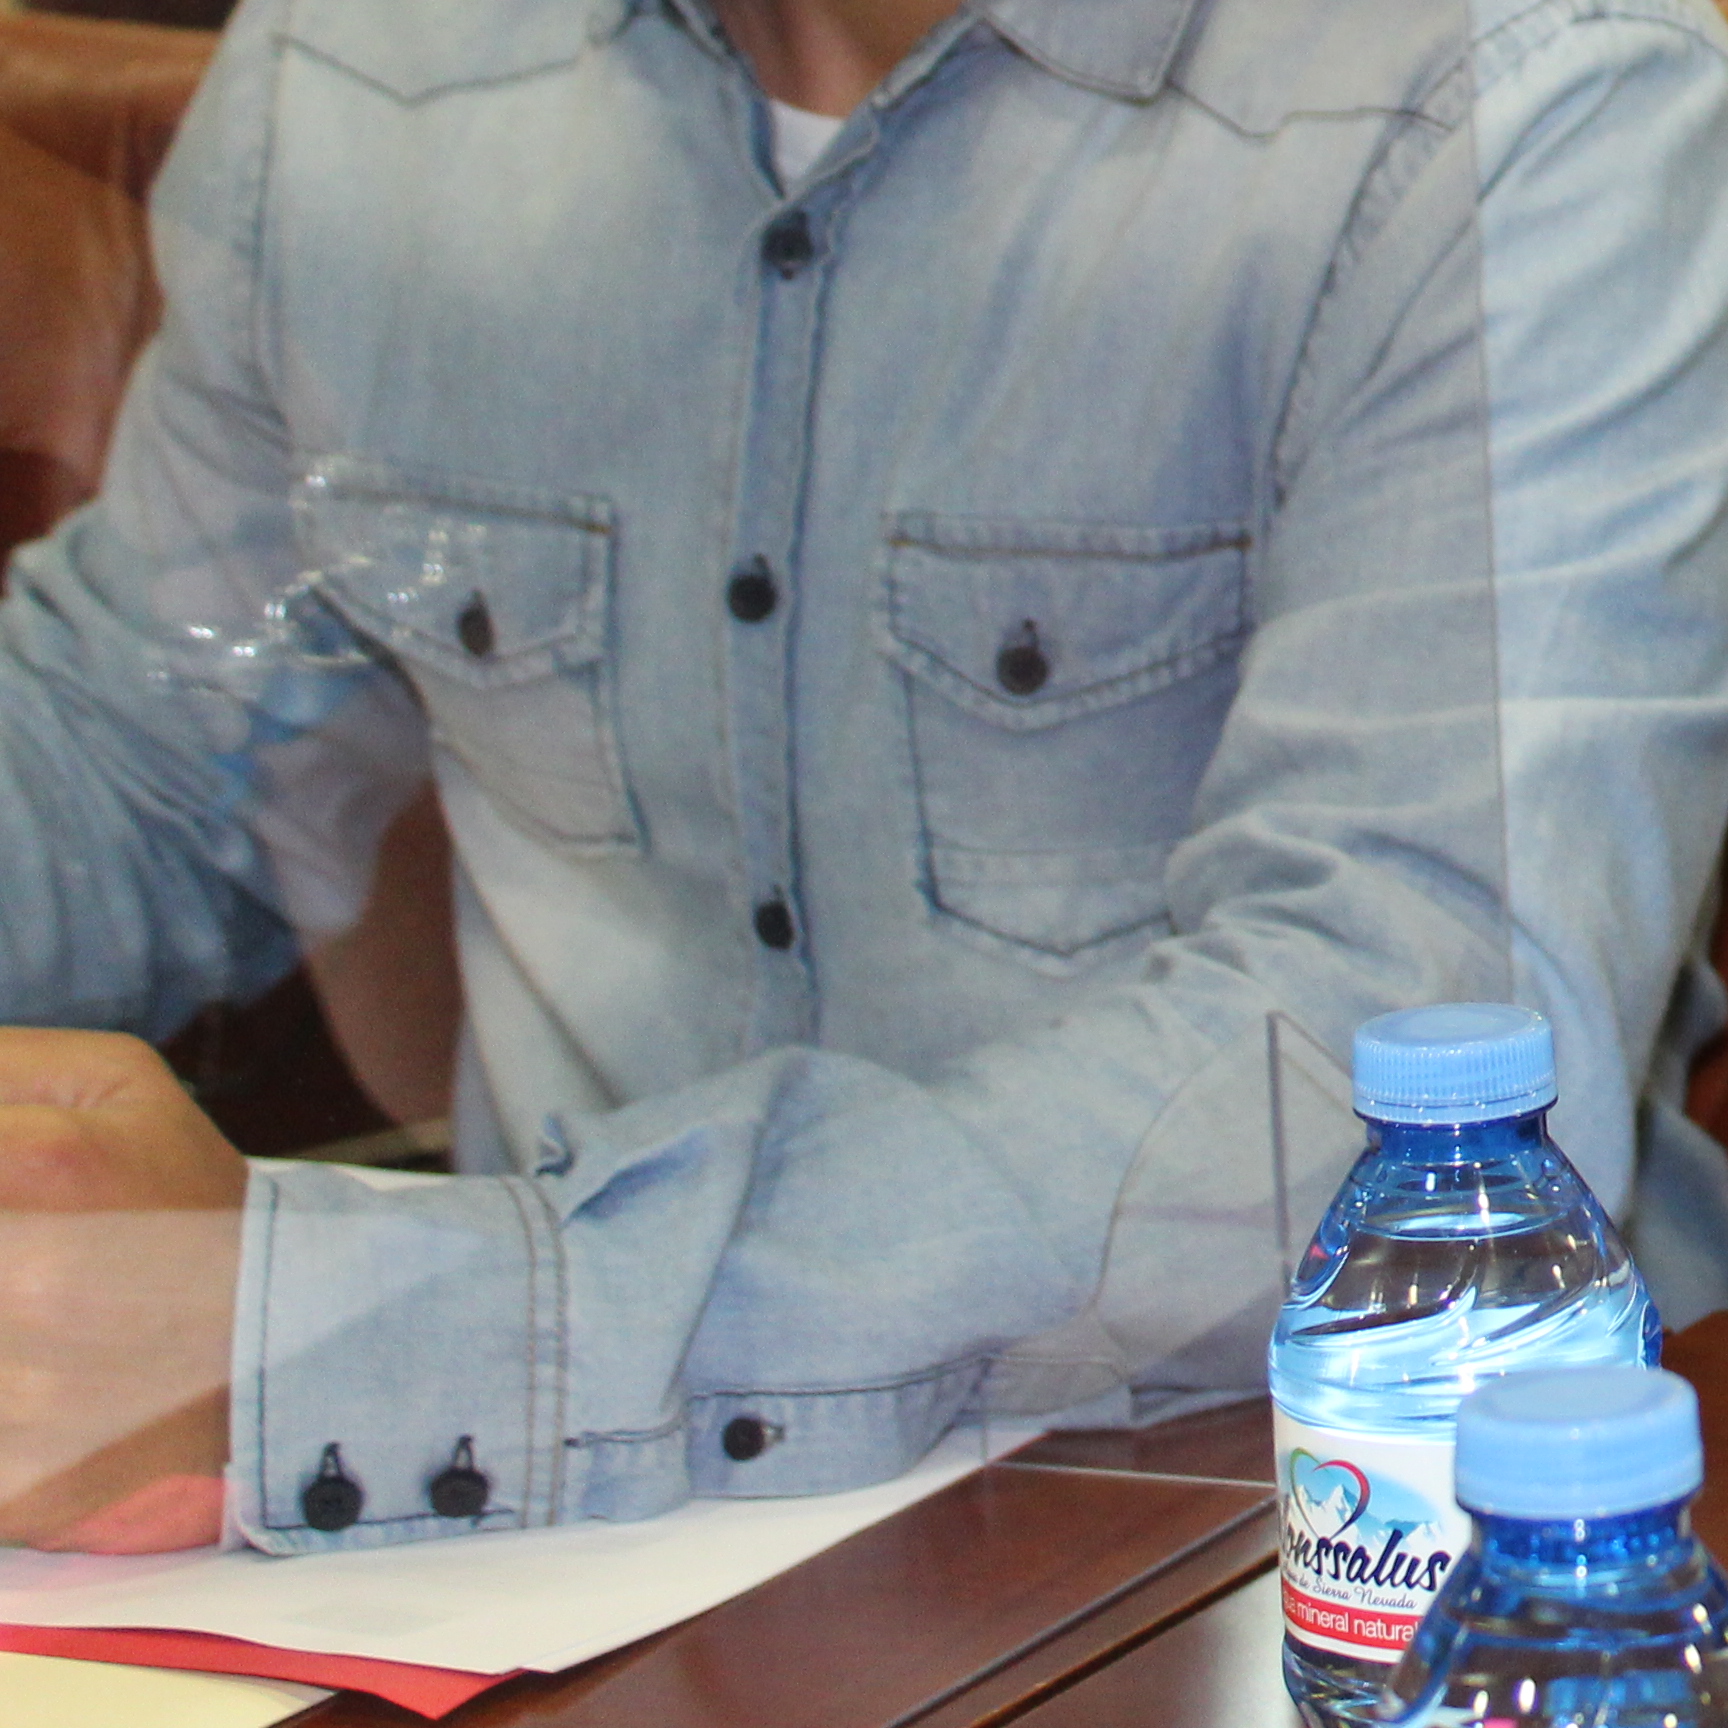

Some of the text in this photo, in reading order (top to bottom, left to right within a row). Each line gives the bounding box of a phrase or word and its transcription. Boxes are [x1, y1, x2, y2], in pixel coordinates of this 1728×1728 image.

[1312, 1575, 1352, 1601] Sierra
[1355, 1587, 1417, 1610] Nevada
[1297, 1601, 1349, 1633] mineral
